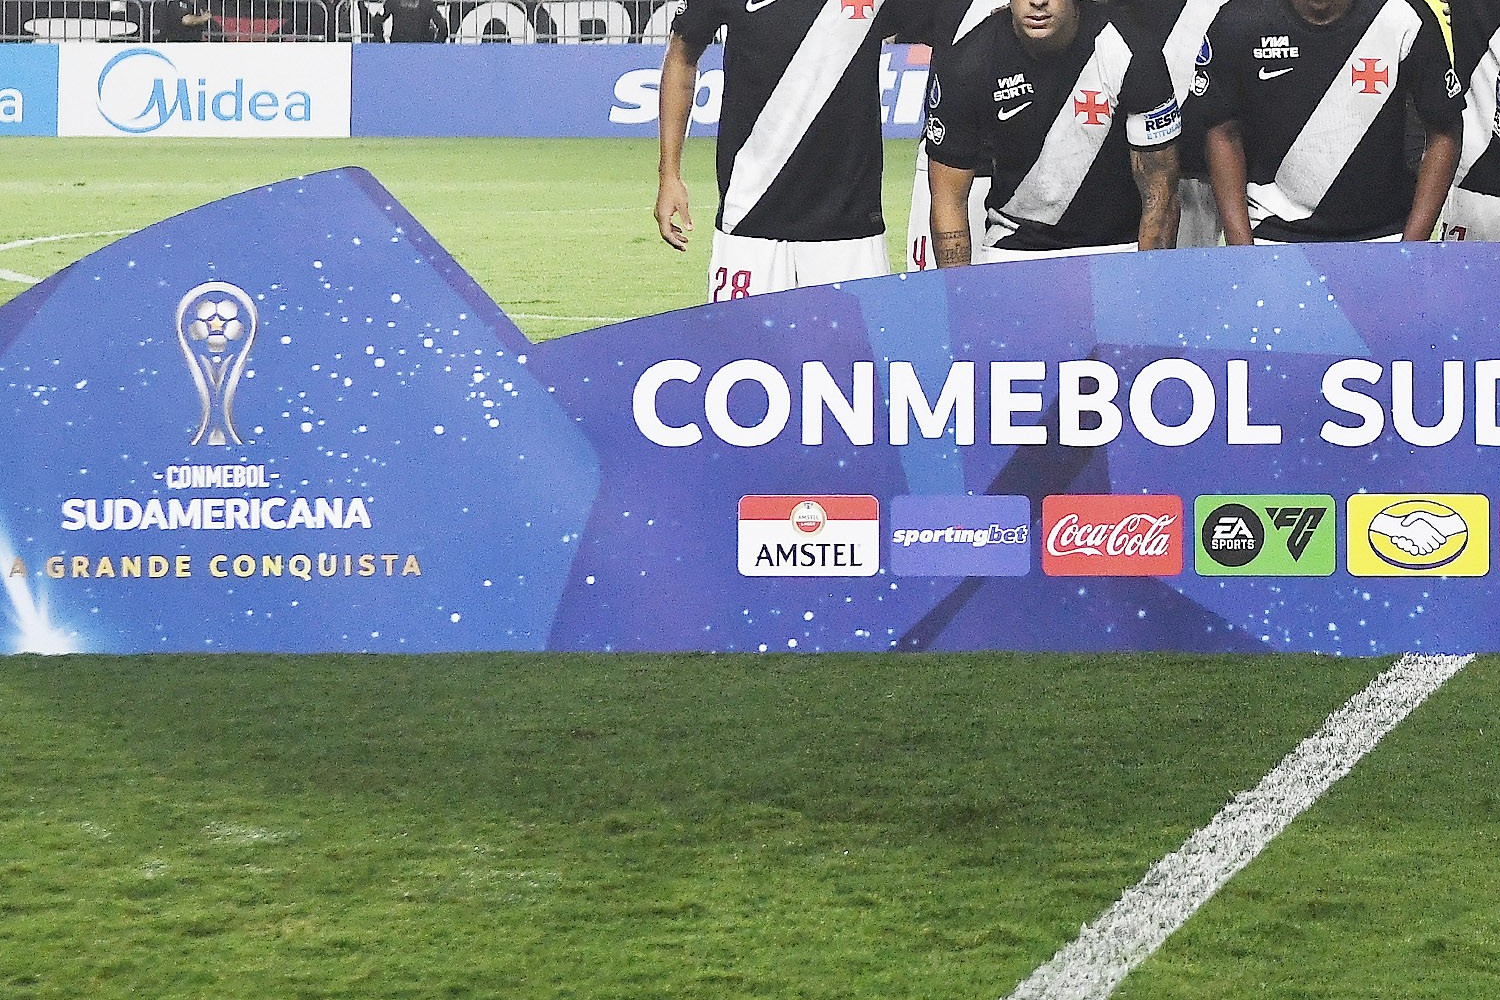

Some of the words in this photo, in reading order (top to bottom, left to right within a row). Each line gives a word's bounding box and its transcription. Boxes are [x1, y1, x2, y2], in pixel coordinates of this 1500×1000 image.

[1253, 46, 1299, 59] SORTE
[1260, 35, 1290, 47] VIVA
[993, 82, 1034, 102] SORTE
[997, 73, 1025, 88] VIVA
[130, 74, 312, 125] Midea
[631, 358, 1283, 448] CONMEBOL
[61, 496, 373, 532] SUDAMERICANA
[892, 524, 1029, 547] sportingbet
[1046, 513, 1178, 557] Coca-Cola
[1212, 517, 1254, 538] EA
[754, 543, 863, 567] AMSTEL
[1211, 538, 1255, 550] SPORTS
[46, 555, 193, 579] GRANDE
[209, 553, 423, 582] CONQUISTA
